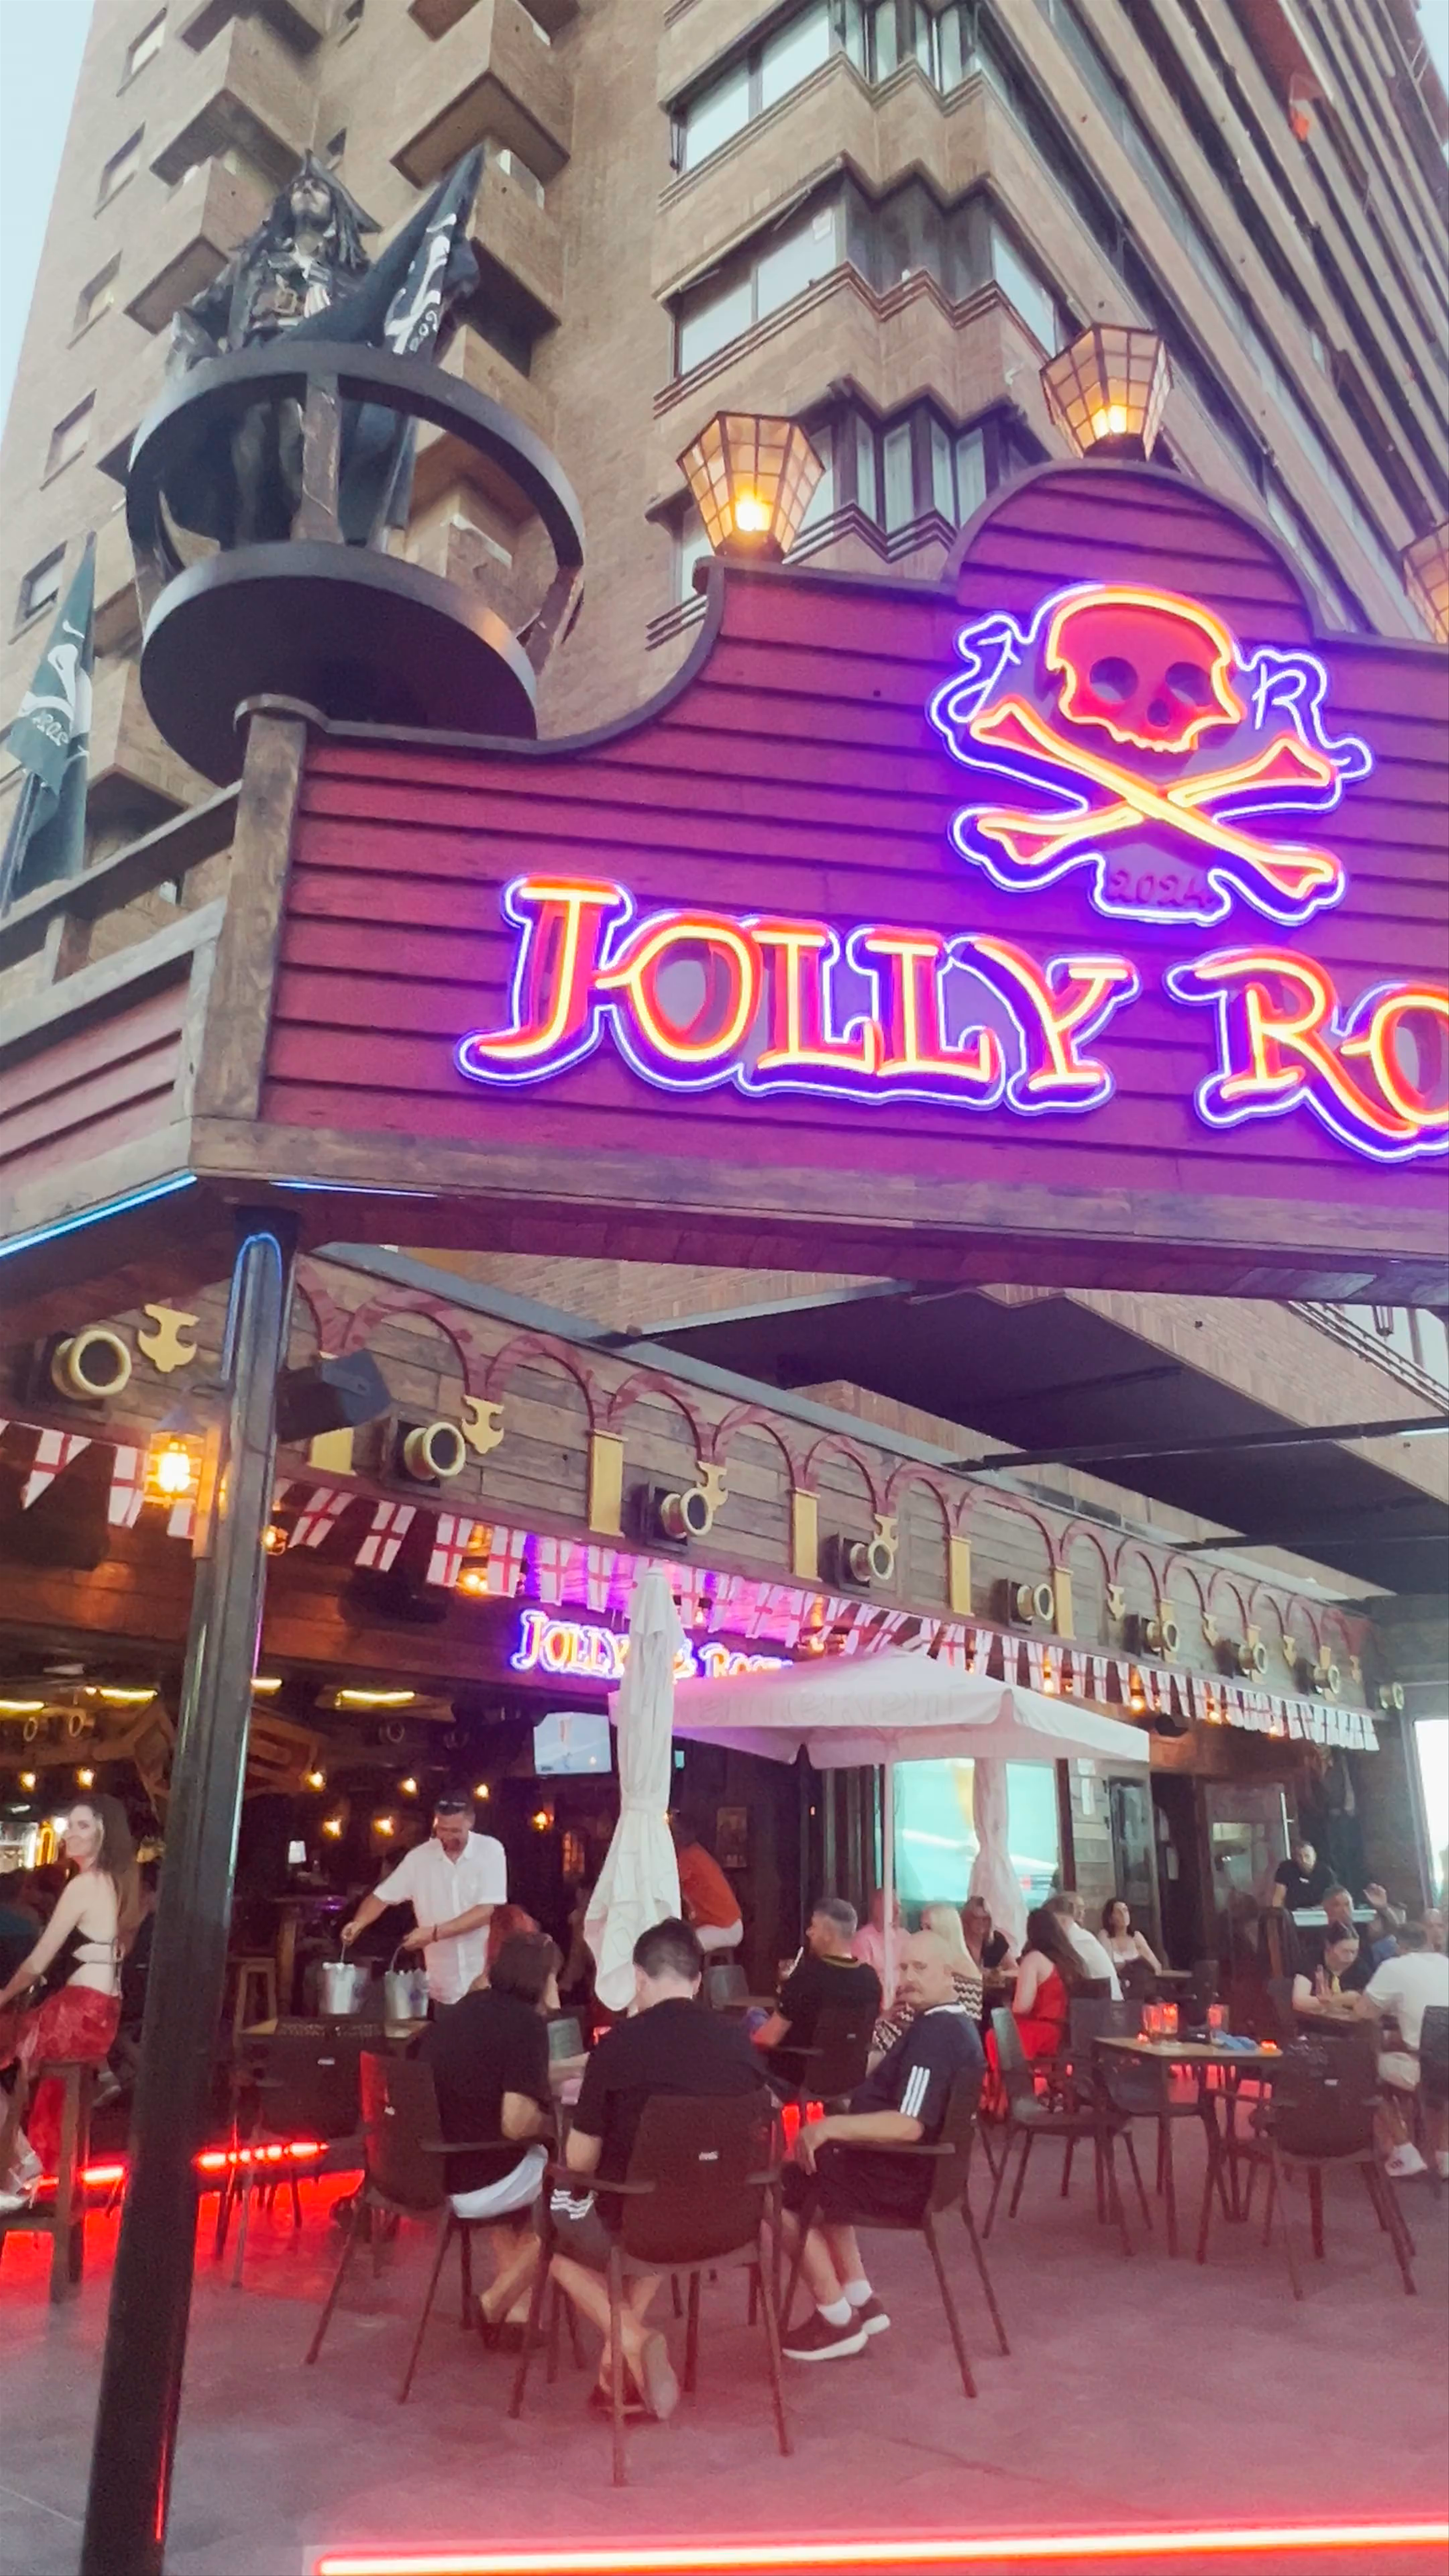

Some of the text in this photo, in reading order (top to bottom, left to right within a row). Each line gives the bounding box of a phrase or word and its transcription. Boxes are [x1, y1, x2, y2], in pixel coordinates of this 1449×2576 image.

[1106, 870, 1214, 909] 2024
[462, 875, 1136, 1104] JOLLY
[511, 1609, 630, 1678] JOLLY
